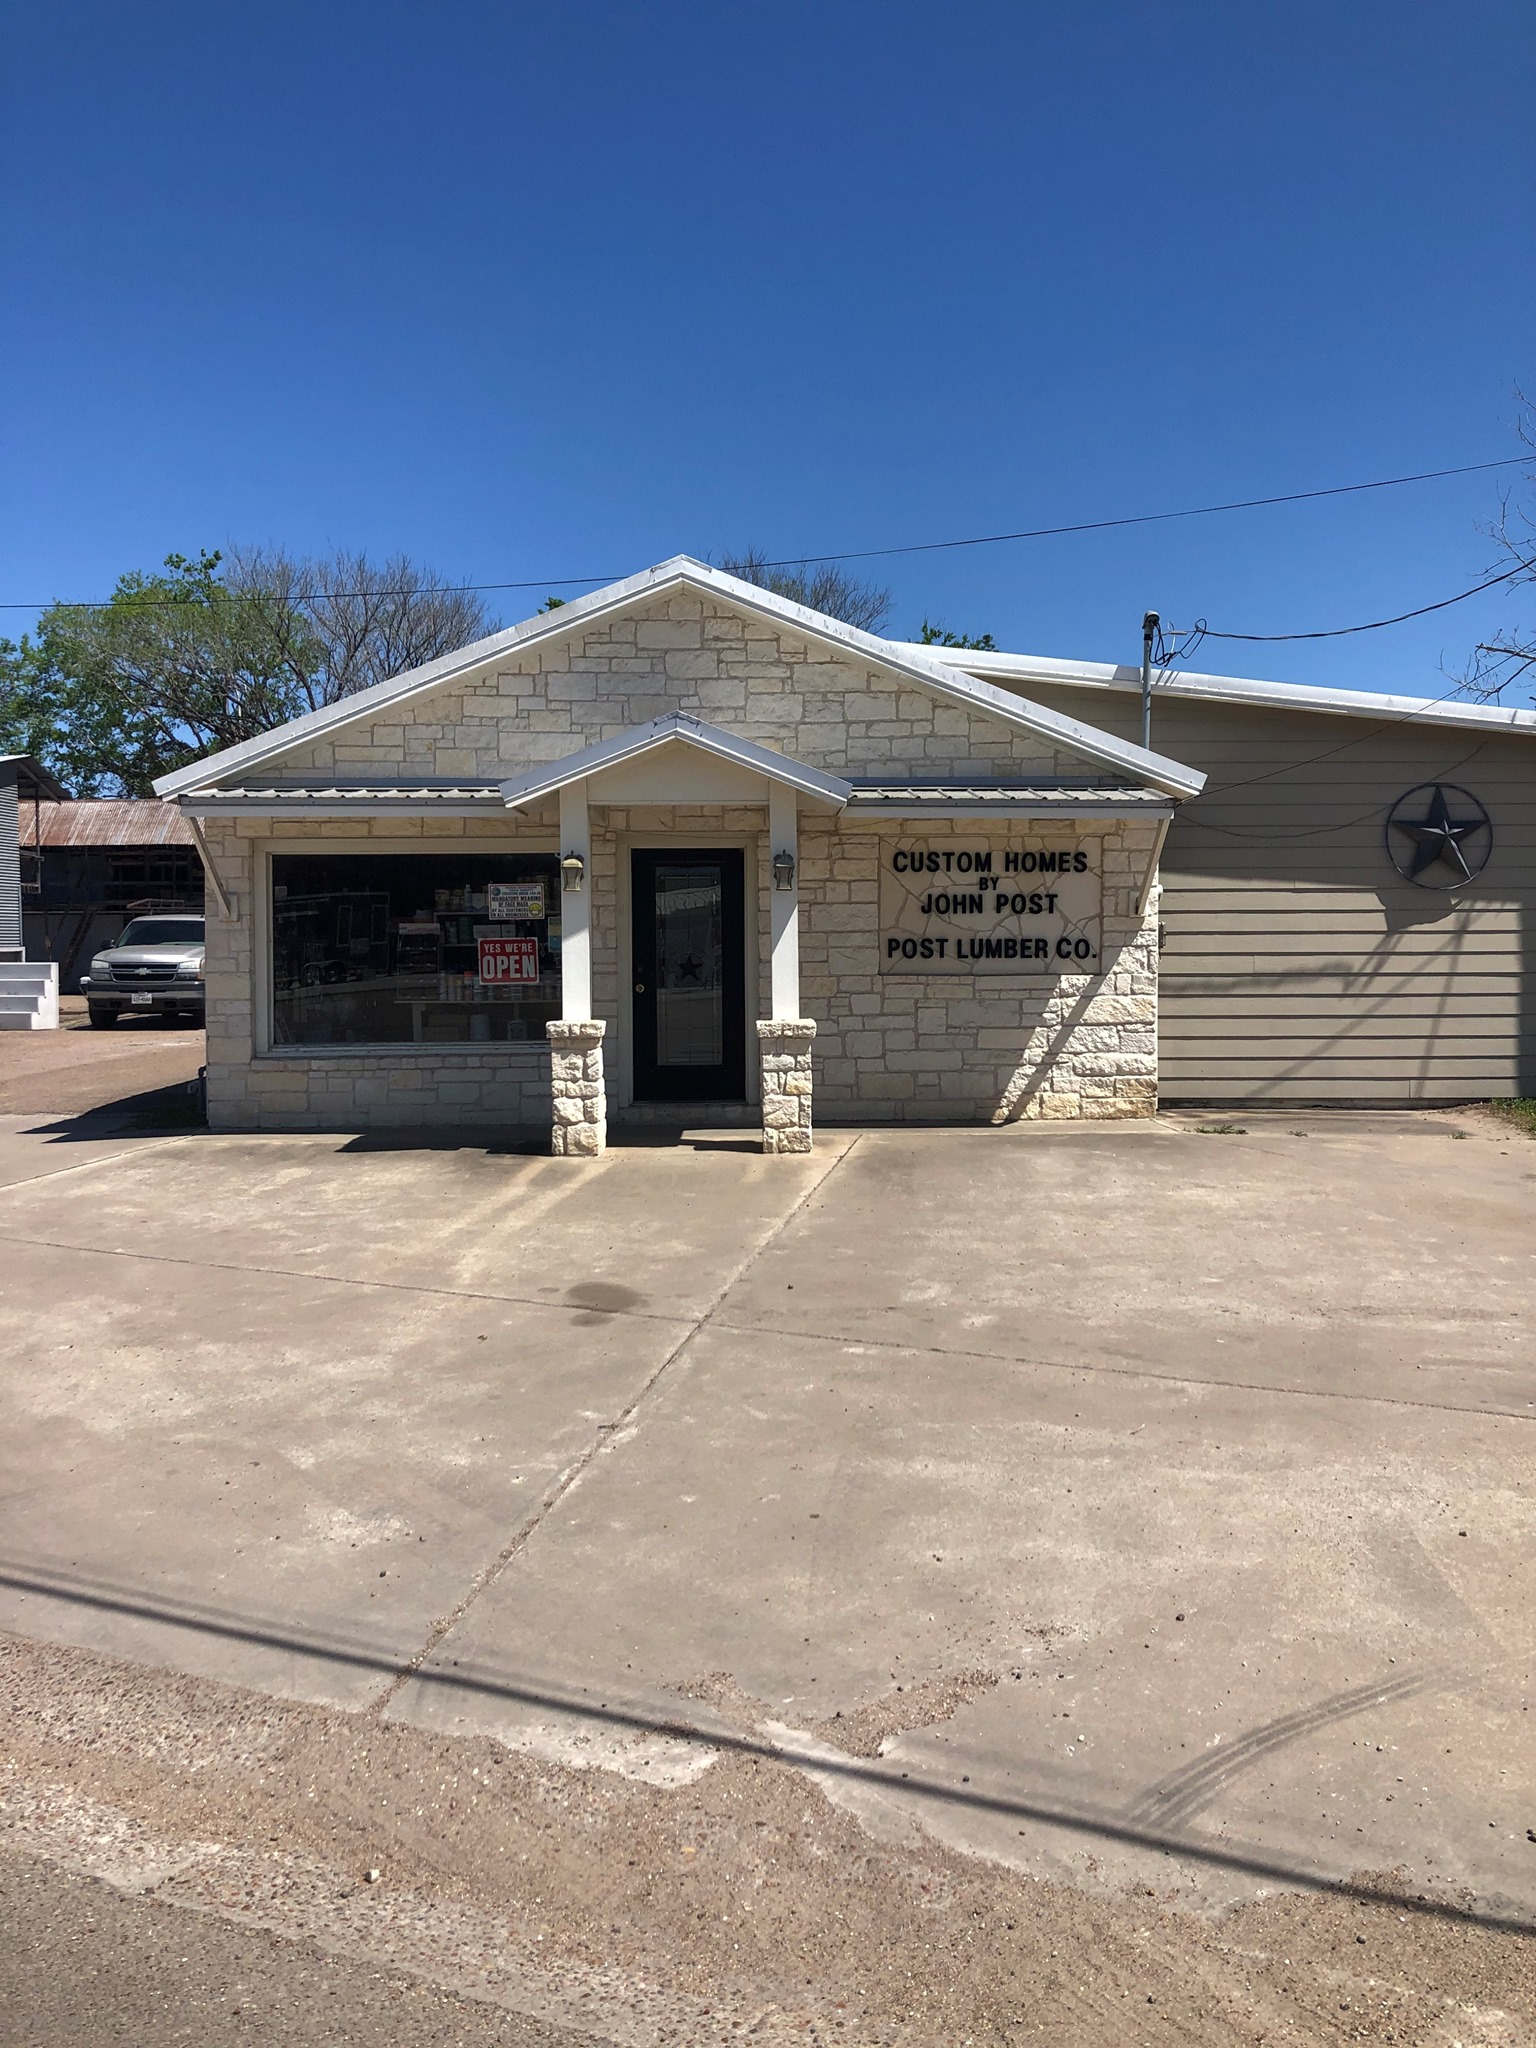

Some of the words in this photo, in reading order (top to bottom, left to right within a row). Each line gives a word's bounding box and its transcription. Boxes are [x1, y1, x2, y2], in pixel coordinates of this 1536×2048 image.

[892, 851, 992, 873] CUSTOM
[1004, 851, 1088, 873] HOMES
[979, 876, 1000, 891] BY
[920, 893, 983, 914] JOHN
[995, 893, 1058, 914] POST
[484, 944, 501, 953] YES
[505, 943, 533, 953] WE'RE
[887, 938, 949, 959] POST
[957, 938, 1048, 959] LUMBER
[1056, 938, 1097, 959] CO.
[482, 955, 536, 979] OPEN
